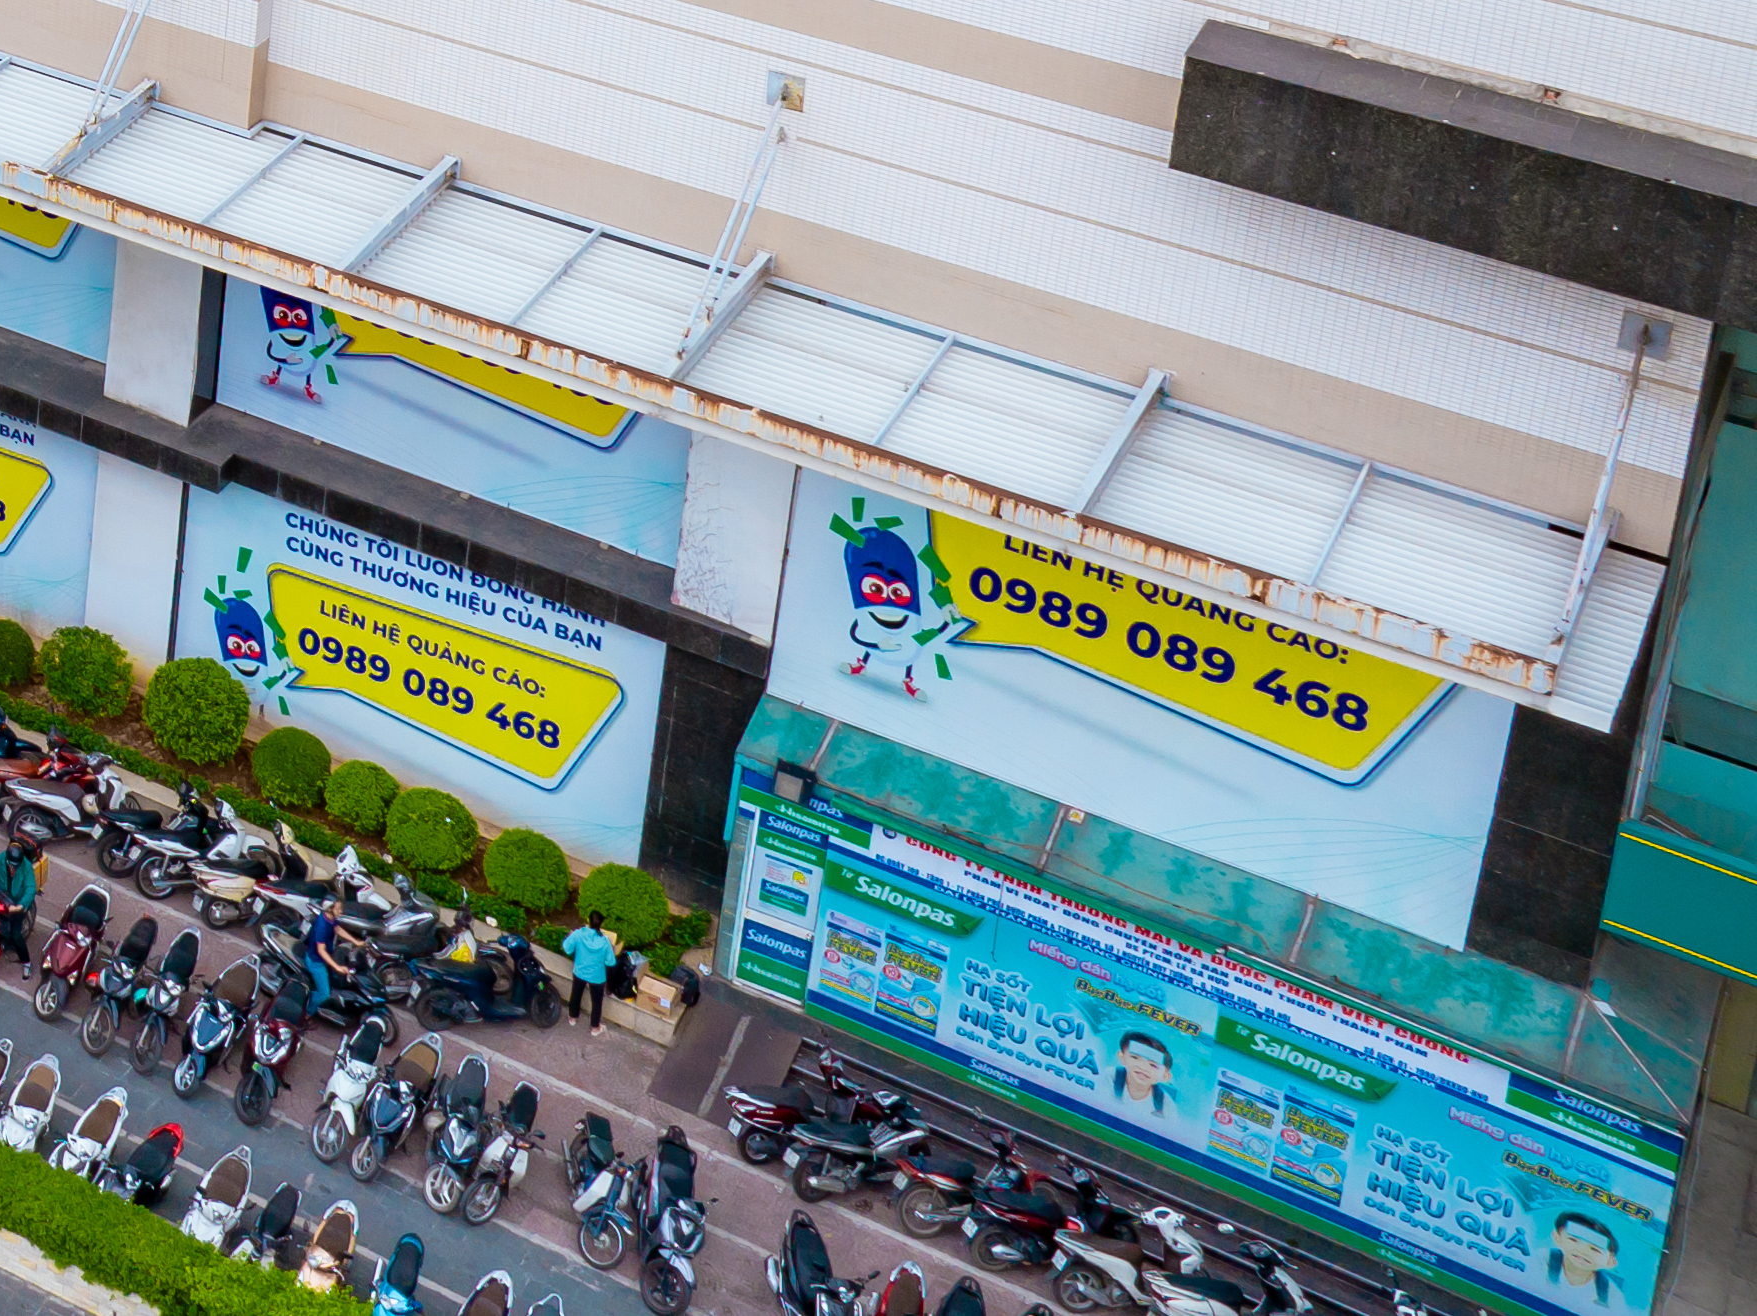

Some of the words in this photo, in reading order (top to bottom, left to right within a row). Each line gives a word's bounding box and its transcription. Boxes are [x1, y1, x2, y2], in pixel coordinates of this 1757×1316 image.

[0, 421, 35, 446] BẠN
[286, 512, 358, 548] CHÚNG
[286, 536, 344, 568] CÙNG
[349, 556, 440, 599] THƯƠNG
[445, 587, 496, 617] HIỆU
[502, 602, 549, 635] CỦA
[554, 620, 603, 652] BẠN
[319, 599, 366, 630] LIÊN
[372, 620, 401, 648] HỆ
[407, 634, 486, 676] QUẢNG
[492, 665, 547, 699] CÁO:
[969, 566, 1108, 640] 0989
[1126, 620, 1236, 684] 089
[1254, 668, 1369, 732] 468
[298, 628, 391, 683] 0989
[402, 668, 475, 715] 089
[485, 702, 561, 750] 468
[766, 815, 822, 843] Salonpas
[854, 875, 957, 930] Salonpas
[745, 928, 807, 960] Salonpas
[1028, 938, 1078, 969] Miếng
[1079, 960, 1113, 982] dán
[965, 959, 990, 980] HẠ
[995, 969, 1031, 993] SỐT
[961, 974, 1028, 1017] TIỆN
[1034, 1004, 1085, 1041] LỢI
[958, 1001, 1028, 1046] HIỆU
[1034, 1034, 1100, 1075] QUẢ
[969, 1057, 1020, 1087] Salonpas
[1045, 1062, 1095, 1091] FEVER
[1250, 1033, 1367, 1092] Salonpas
[1448, 1105, 1506, 1142] Miếng
[1508, 1130, 1546, 1157] dán
[1552, 1089, 1643, 1135] Salonpas
[1374, 1122, 1404, 1147] HẠ
[1409, 1137, 1453, 1166] SỐT
[1367, 1140, 1448, 1191] TIỆN
[1454, 1176, 1515, 1219] LỢI
[1366, 1171, 1446, 1220] HIỆU
[1454, 1210, 1531, 1257] QUẢ
[1379, 1229, 1438, 1264] Salonpas
[1466, 1239, 1526, 1273] FEVER
